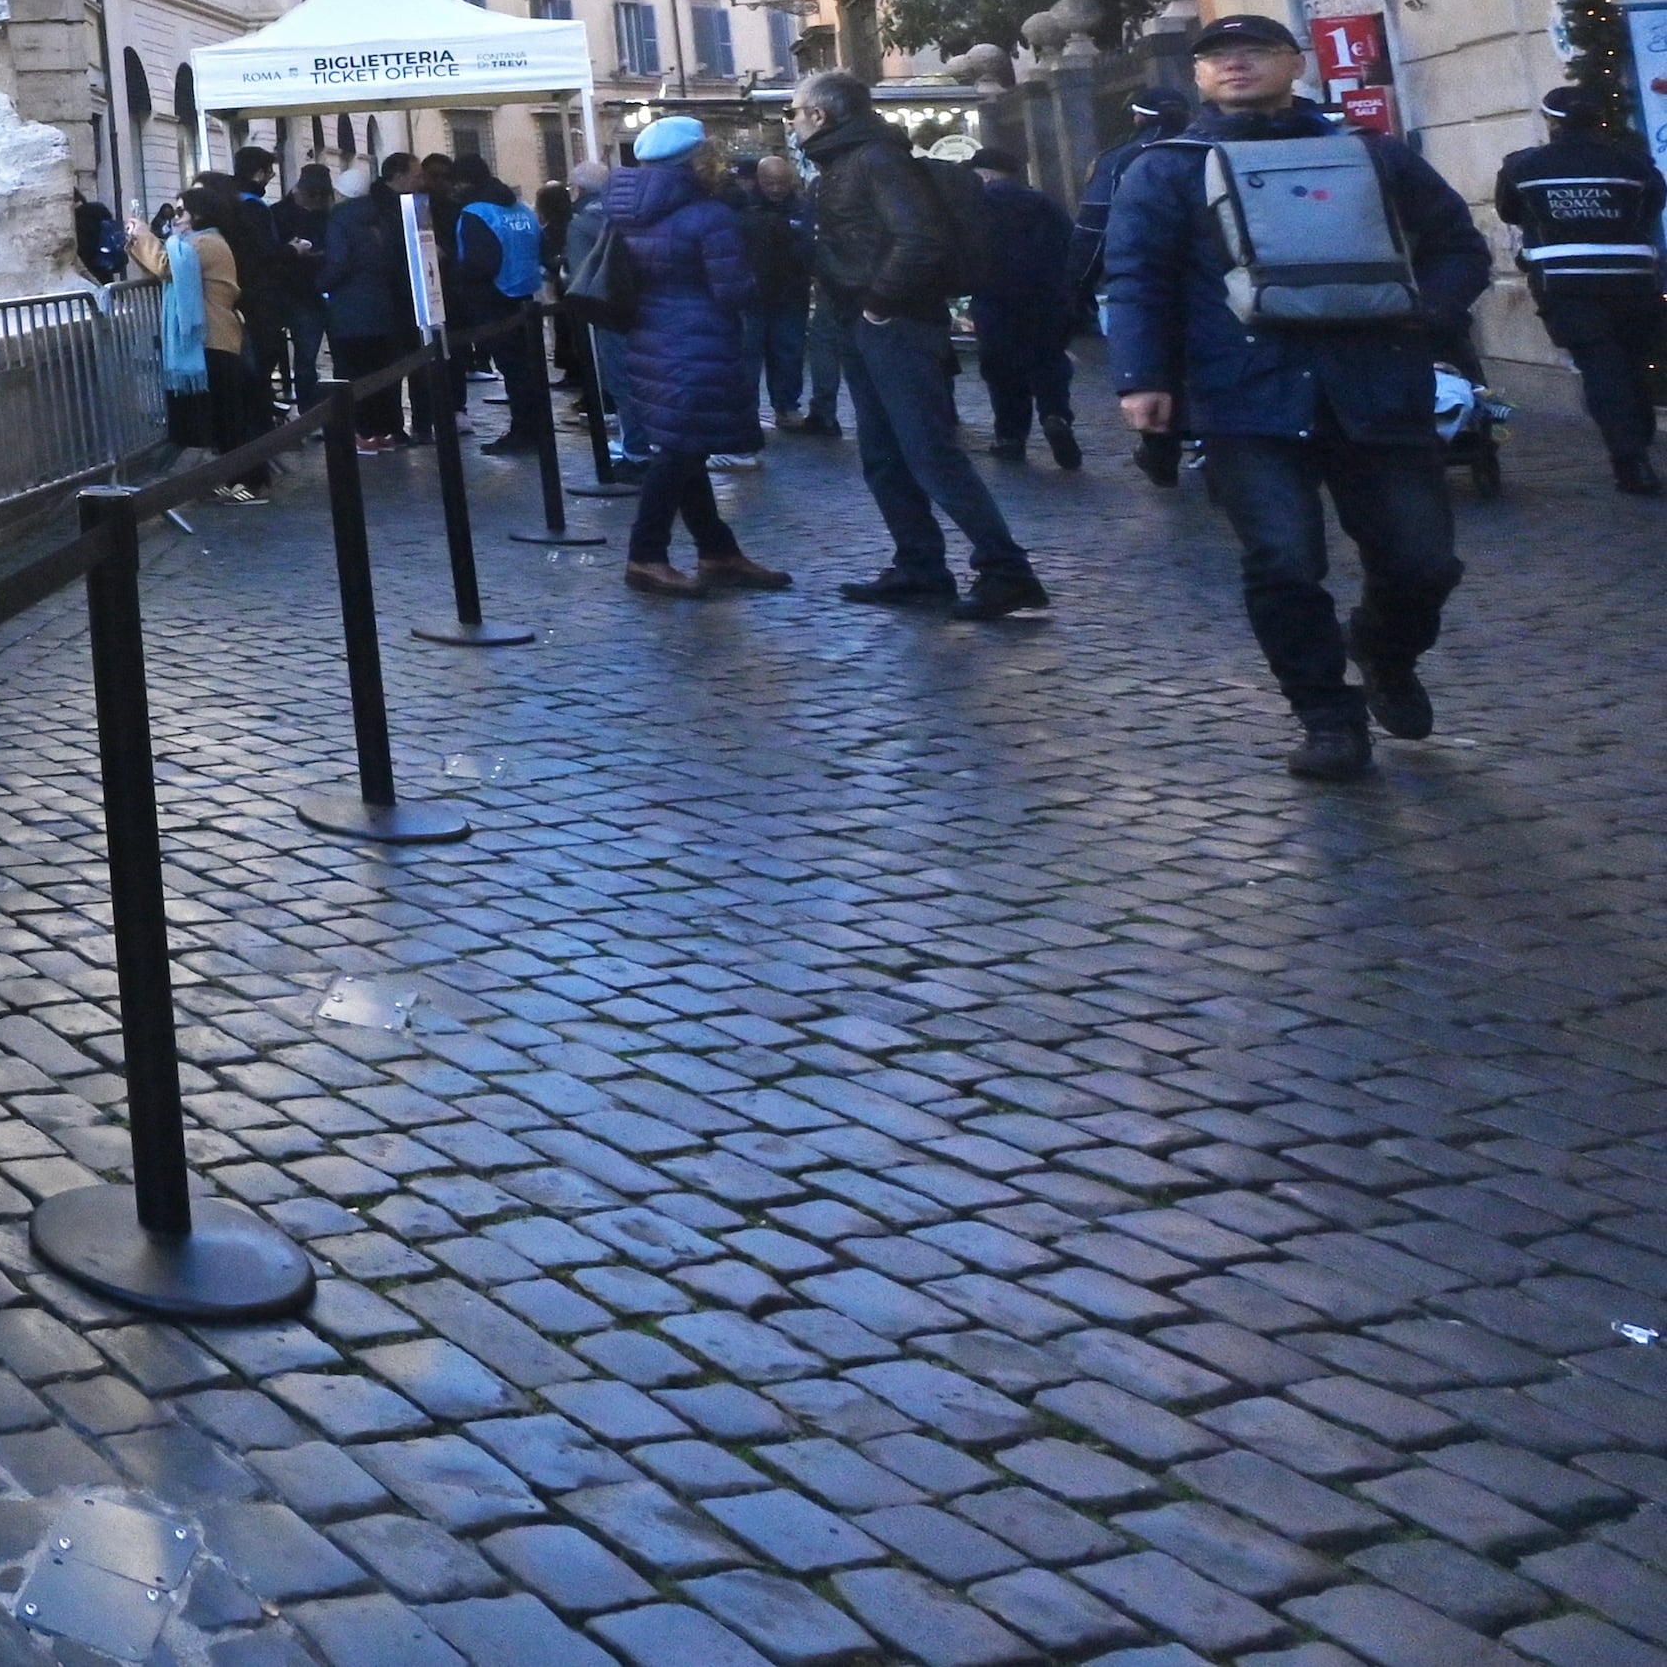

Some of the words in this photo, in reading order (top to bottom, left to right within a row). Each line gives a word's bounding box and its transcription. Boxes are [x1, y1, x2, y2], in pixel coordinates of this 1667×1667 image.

[313, 50, 454, 70] BIGLIETTERIA
[476, 51, 527, 61] FONTANA
[492, 59, 527, 69] TREVI
[243, 70, 282, 83] ROMA
[309, 66, 377, 85] TICKET
[384, 63, 460, 82] OFFICE
[1347, 99, 1383, 109] SPECIAL
[1547, 189, 1612, 199] POLIZIA
[1549, 199, 1600, 209] ROMA
